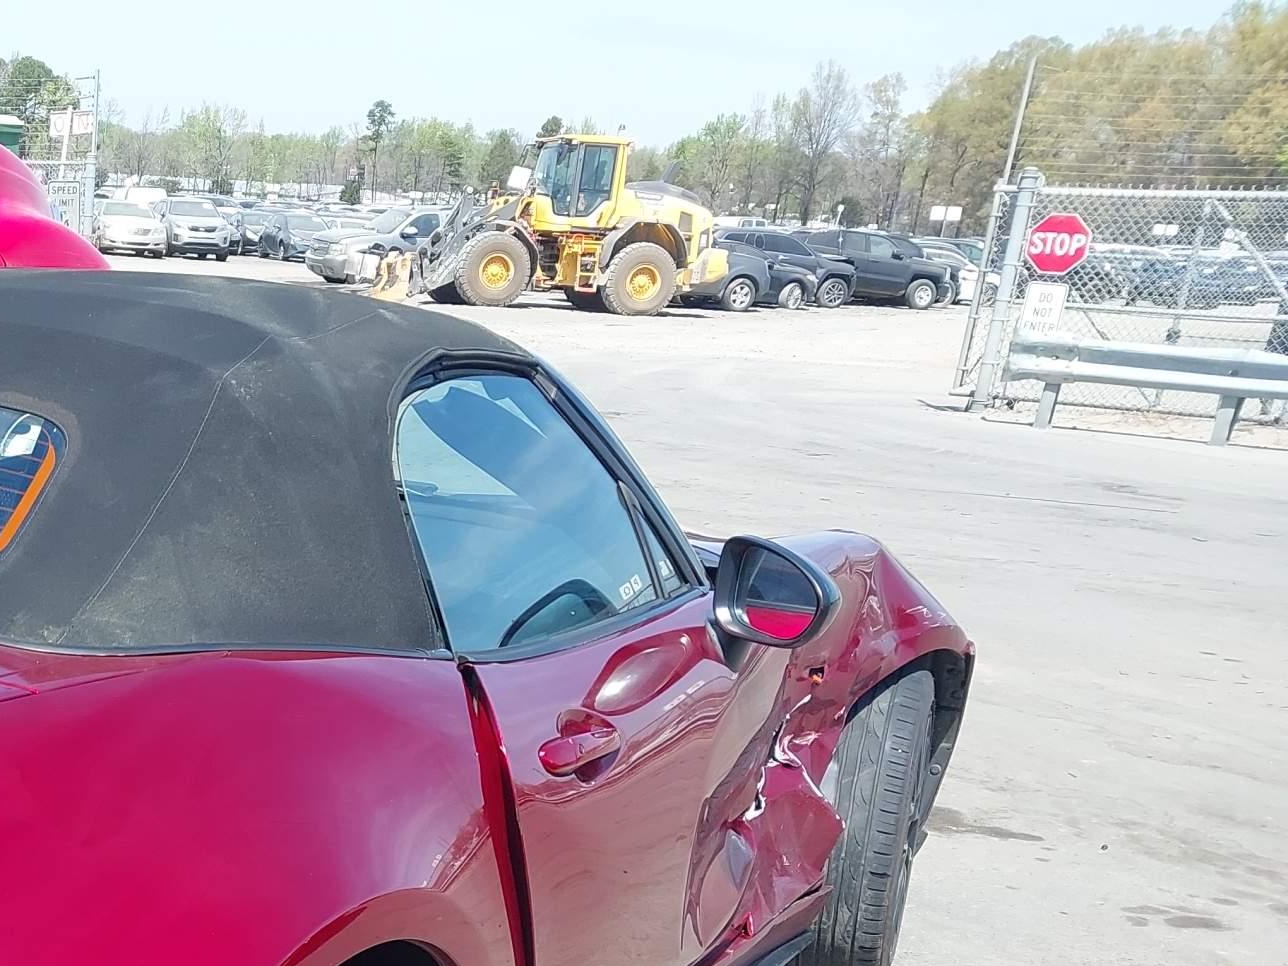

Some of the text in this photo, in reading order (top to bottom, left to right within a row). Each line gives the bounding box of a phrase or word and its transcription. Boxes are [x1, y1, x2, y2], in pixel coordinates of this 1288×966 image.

[51, 186, 78, 195] SPEED
[1029, 231, 1086, 256] STOP
[1039, 292, 1054, 303] DO
[1033, 307, 1053, 318] NOT
